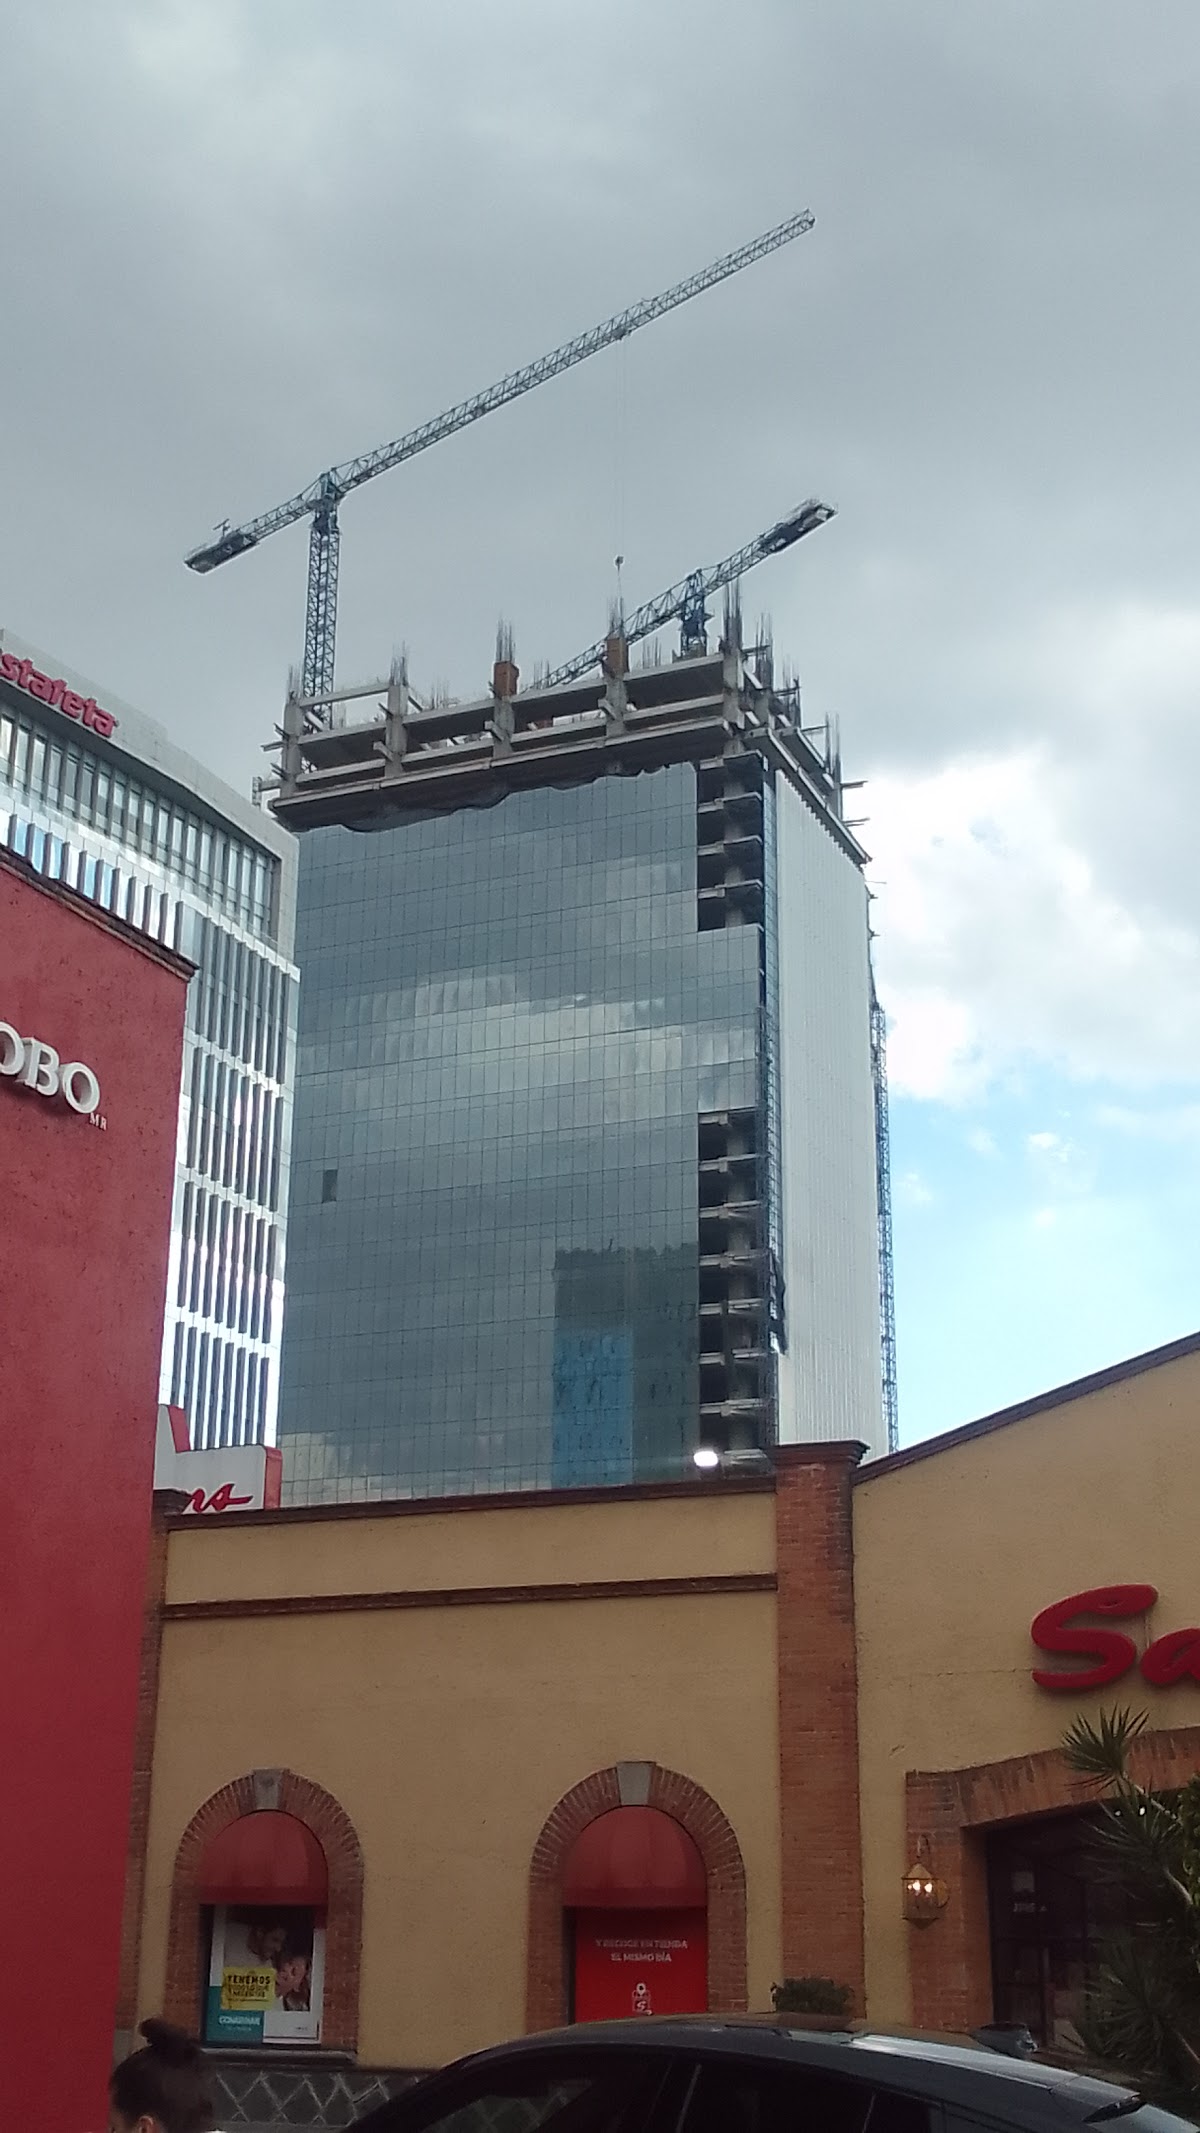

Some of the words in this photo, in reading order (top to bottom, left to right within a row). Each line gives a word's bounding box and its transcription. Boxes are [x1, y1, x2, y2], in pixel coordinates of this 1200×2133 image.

[90, 1112, 108, 1131] MR
[623, 1953, 655, 1962] MISMO
[227, 1975, 271, 1985] TENEMOS
